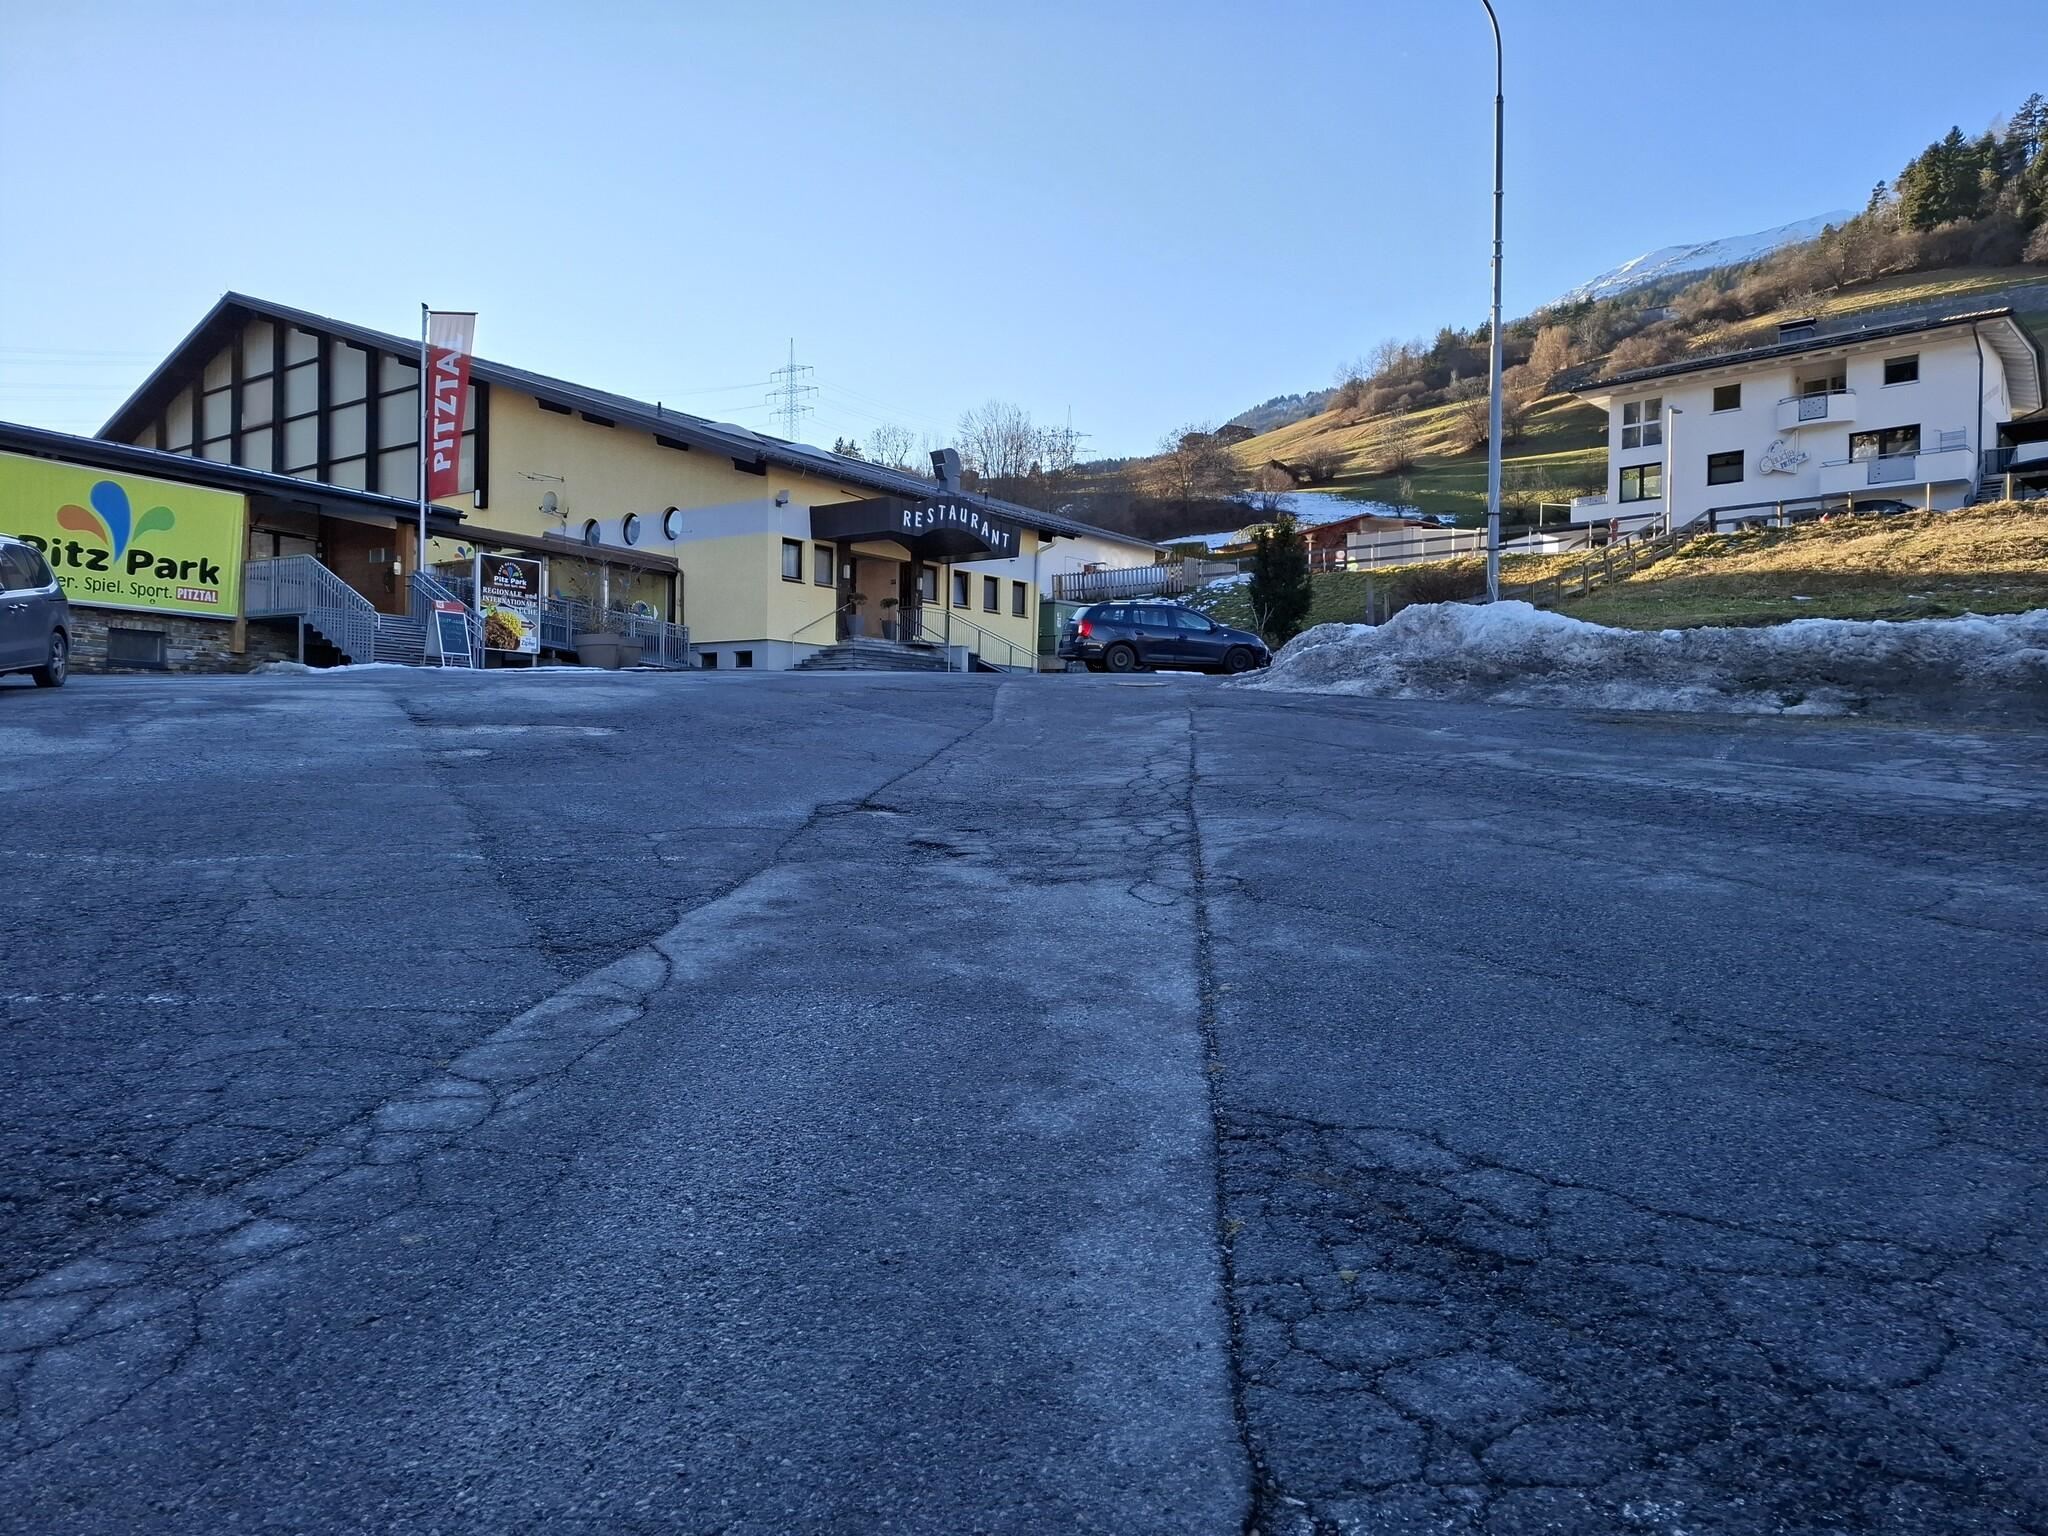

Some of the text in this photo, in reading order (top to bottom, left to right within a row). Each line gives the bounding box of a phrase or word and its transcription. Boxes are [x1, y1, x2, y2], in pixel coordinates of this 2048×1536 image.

[434, 333, 464, 473] PITZTAL
[903, 504, 1010, 549] RESTAURANT
[126, 549, 221, 586] Park
[84, 576, 124, 595] Spiel.
[129, 582, 173, 600] Sport.
[482, 586, 522, 597] REGIONALE
[494, 575, 509, 584] Pitz
[510, 578, 527, 586] Park
[177, 588, 218, 603] PITZTAL
